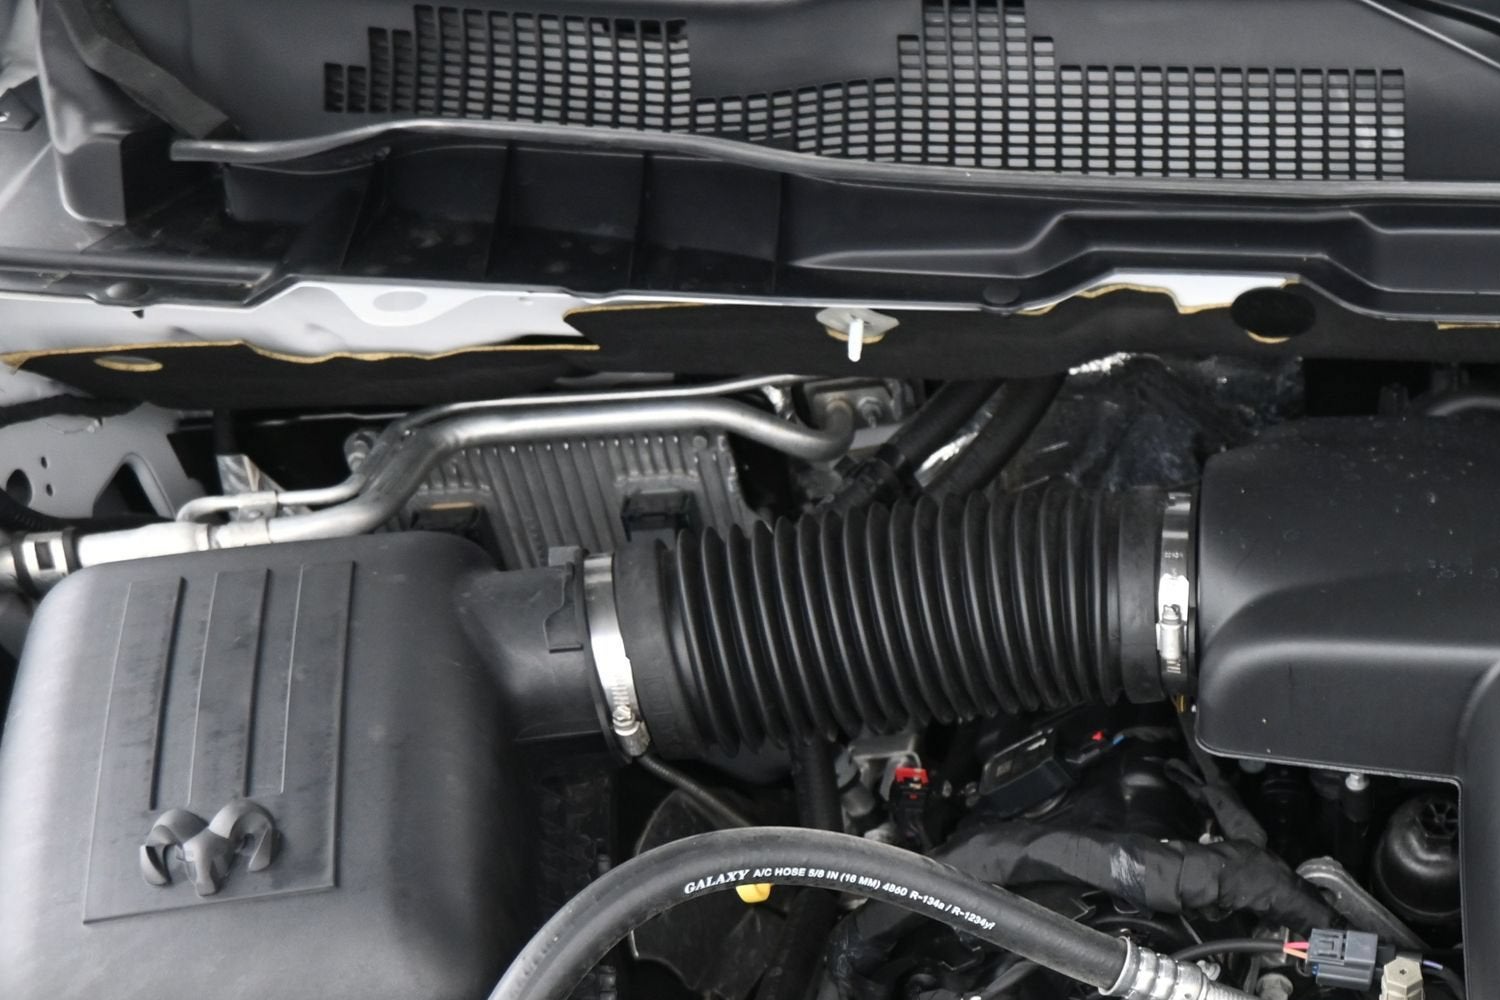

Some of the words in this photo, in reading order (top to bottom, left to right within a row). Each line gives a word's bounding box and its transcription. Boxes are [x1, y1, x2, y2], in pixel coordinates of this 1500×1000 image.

[684, 868, 750, 896] GALAXY
[752, 867, 773, 879] A/C
[774, 866, 806, 878] HOSE
[807, 868, 825, 879] 5/8
[826, 869, 839, 880] IN
[840, 870, 857, 885] (16
[858, 874, 881, 890] MM)
[909, 889, 945, 911] R-134a
[951, 904, 996, 931] R-1234yf
